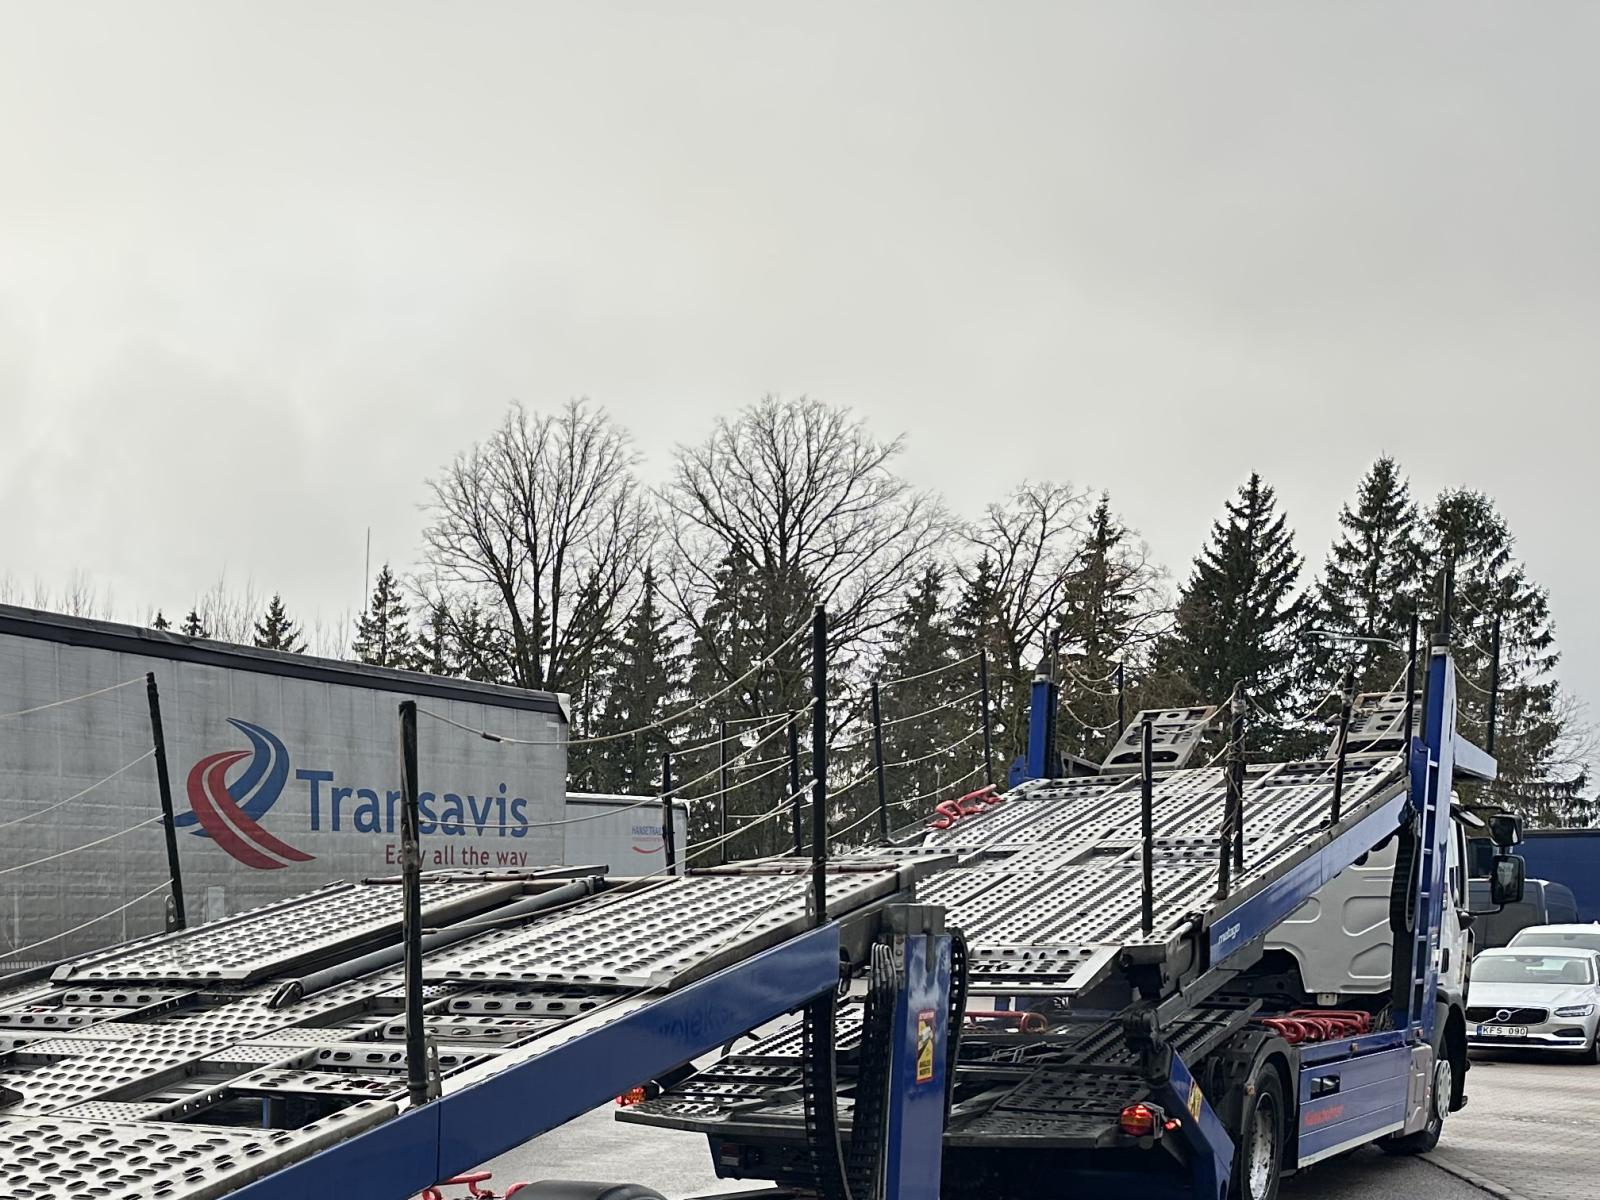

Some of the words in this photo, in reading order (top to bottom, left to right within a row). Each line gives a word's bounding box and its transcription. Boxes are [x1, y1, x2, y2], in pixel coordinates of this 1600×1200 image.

[296, 769, 528, 838] Transavis
[386, 844, 426, 868] Eay
[433, 845, 454, 865] all
[462, 846, 490, 865] the
[497, 851, 528, 867] way
[1483, 1026, 1503, 1034] KFS
